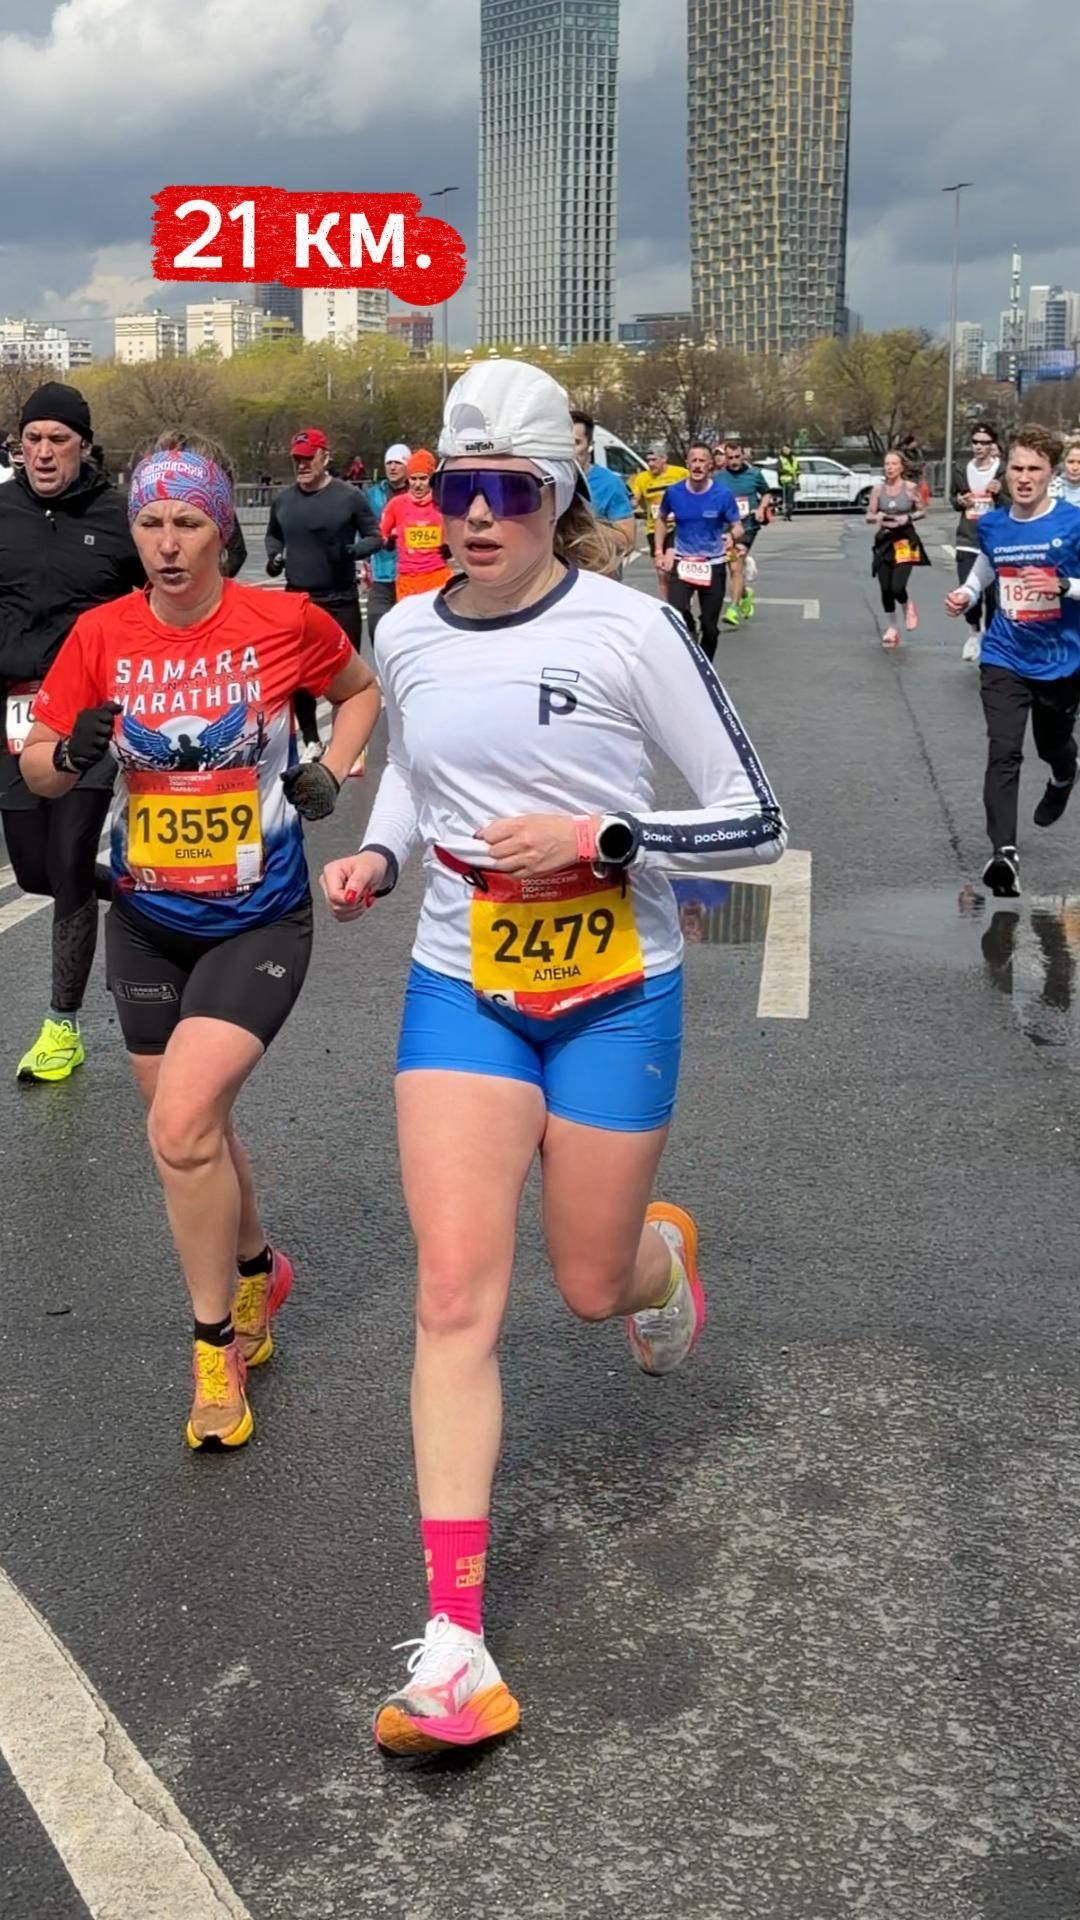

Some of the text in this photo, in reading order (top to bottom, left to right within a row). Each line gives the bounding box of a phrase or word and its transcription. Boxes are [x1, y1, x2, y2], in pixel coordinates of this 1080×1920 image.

[410, 530, 437, 541] 3964
[115, 646, 259, 684] SAMARA
[113, 680, 261, 716] MARATHON
[136, 804, 254, 844] 13559
[694, 829, 749, 845] росбанк
[175, 848, 213, 859] ЕЛЕНА
[491, 908, 615, 963] 2479
